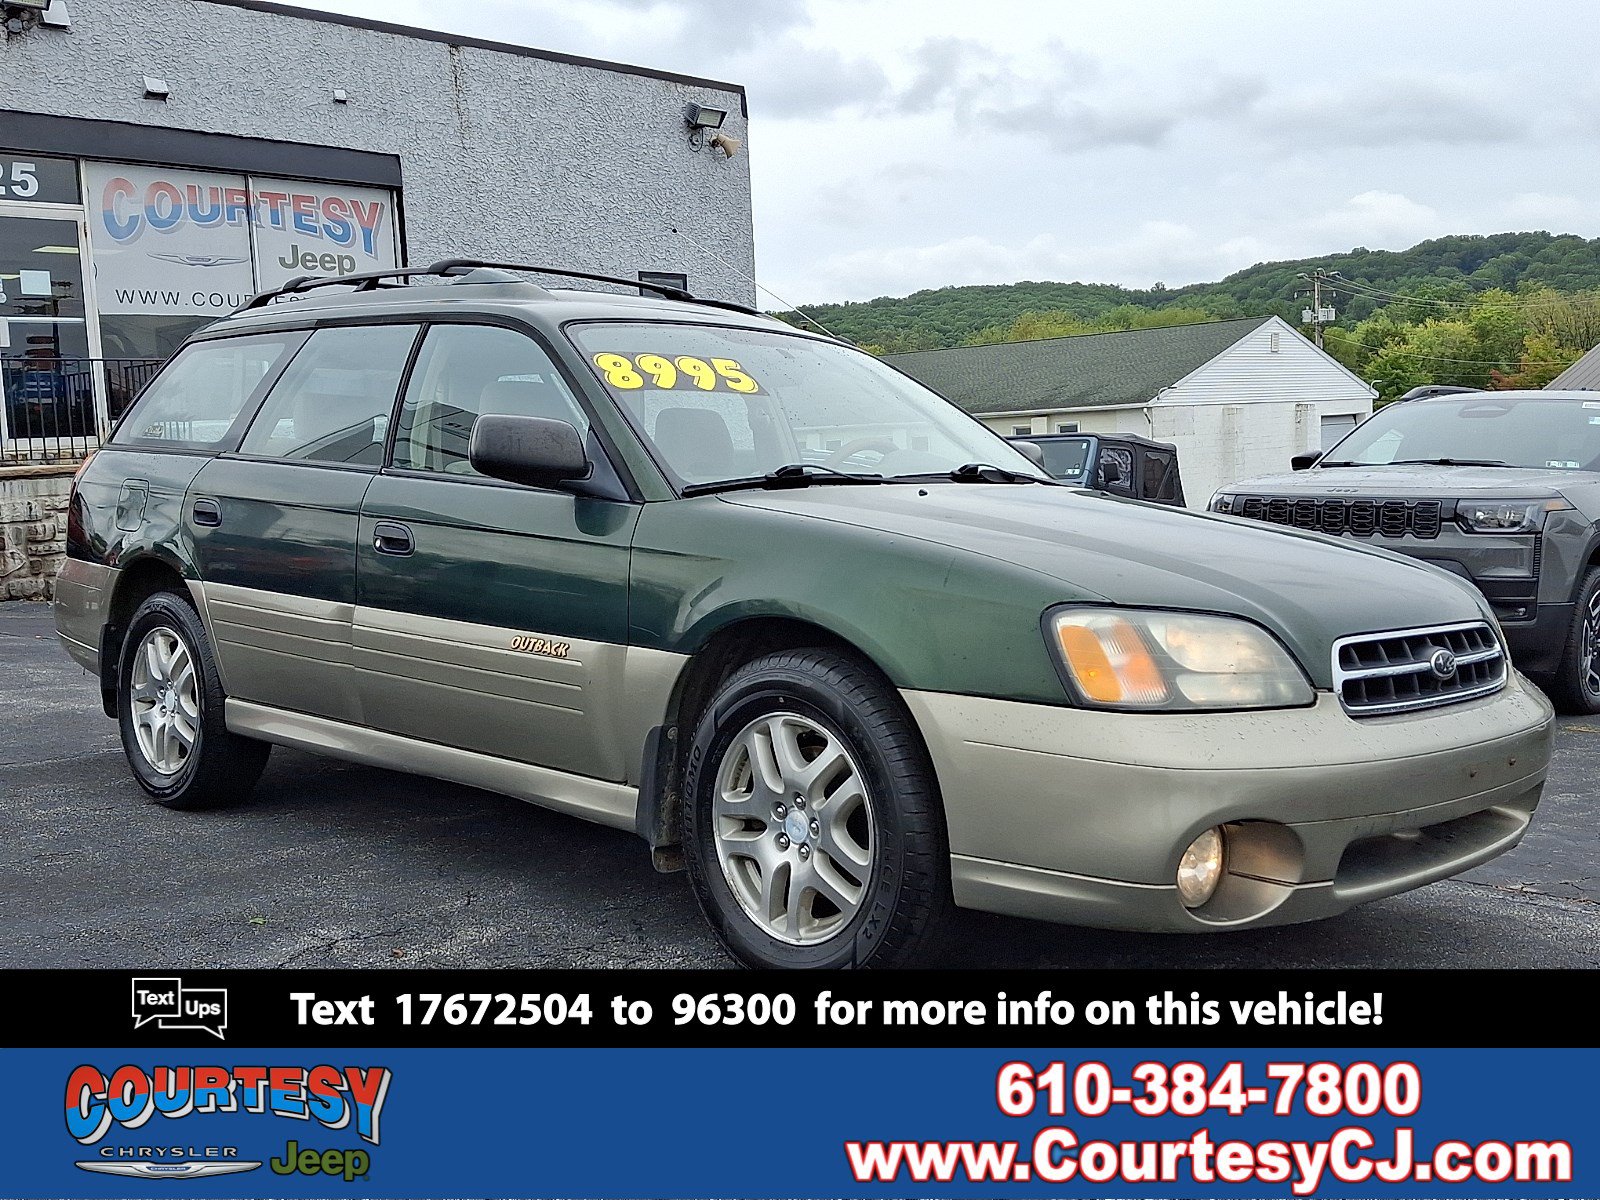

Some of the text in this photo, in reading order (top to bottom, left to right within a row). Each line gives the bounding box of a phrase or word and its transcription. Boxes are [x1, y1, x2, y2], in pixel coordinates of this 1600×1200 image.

[102, 177, 385, 260] COURTESY
[278, 244, 356, 276] Jeep
[593, 352, 759, 394] 8995
[511, 635, 570, 658] OUTBACK
